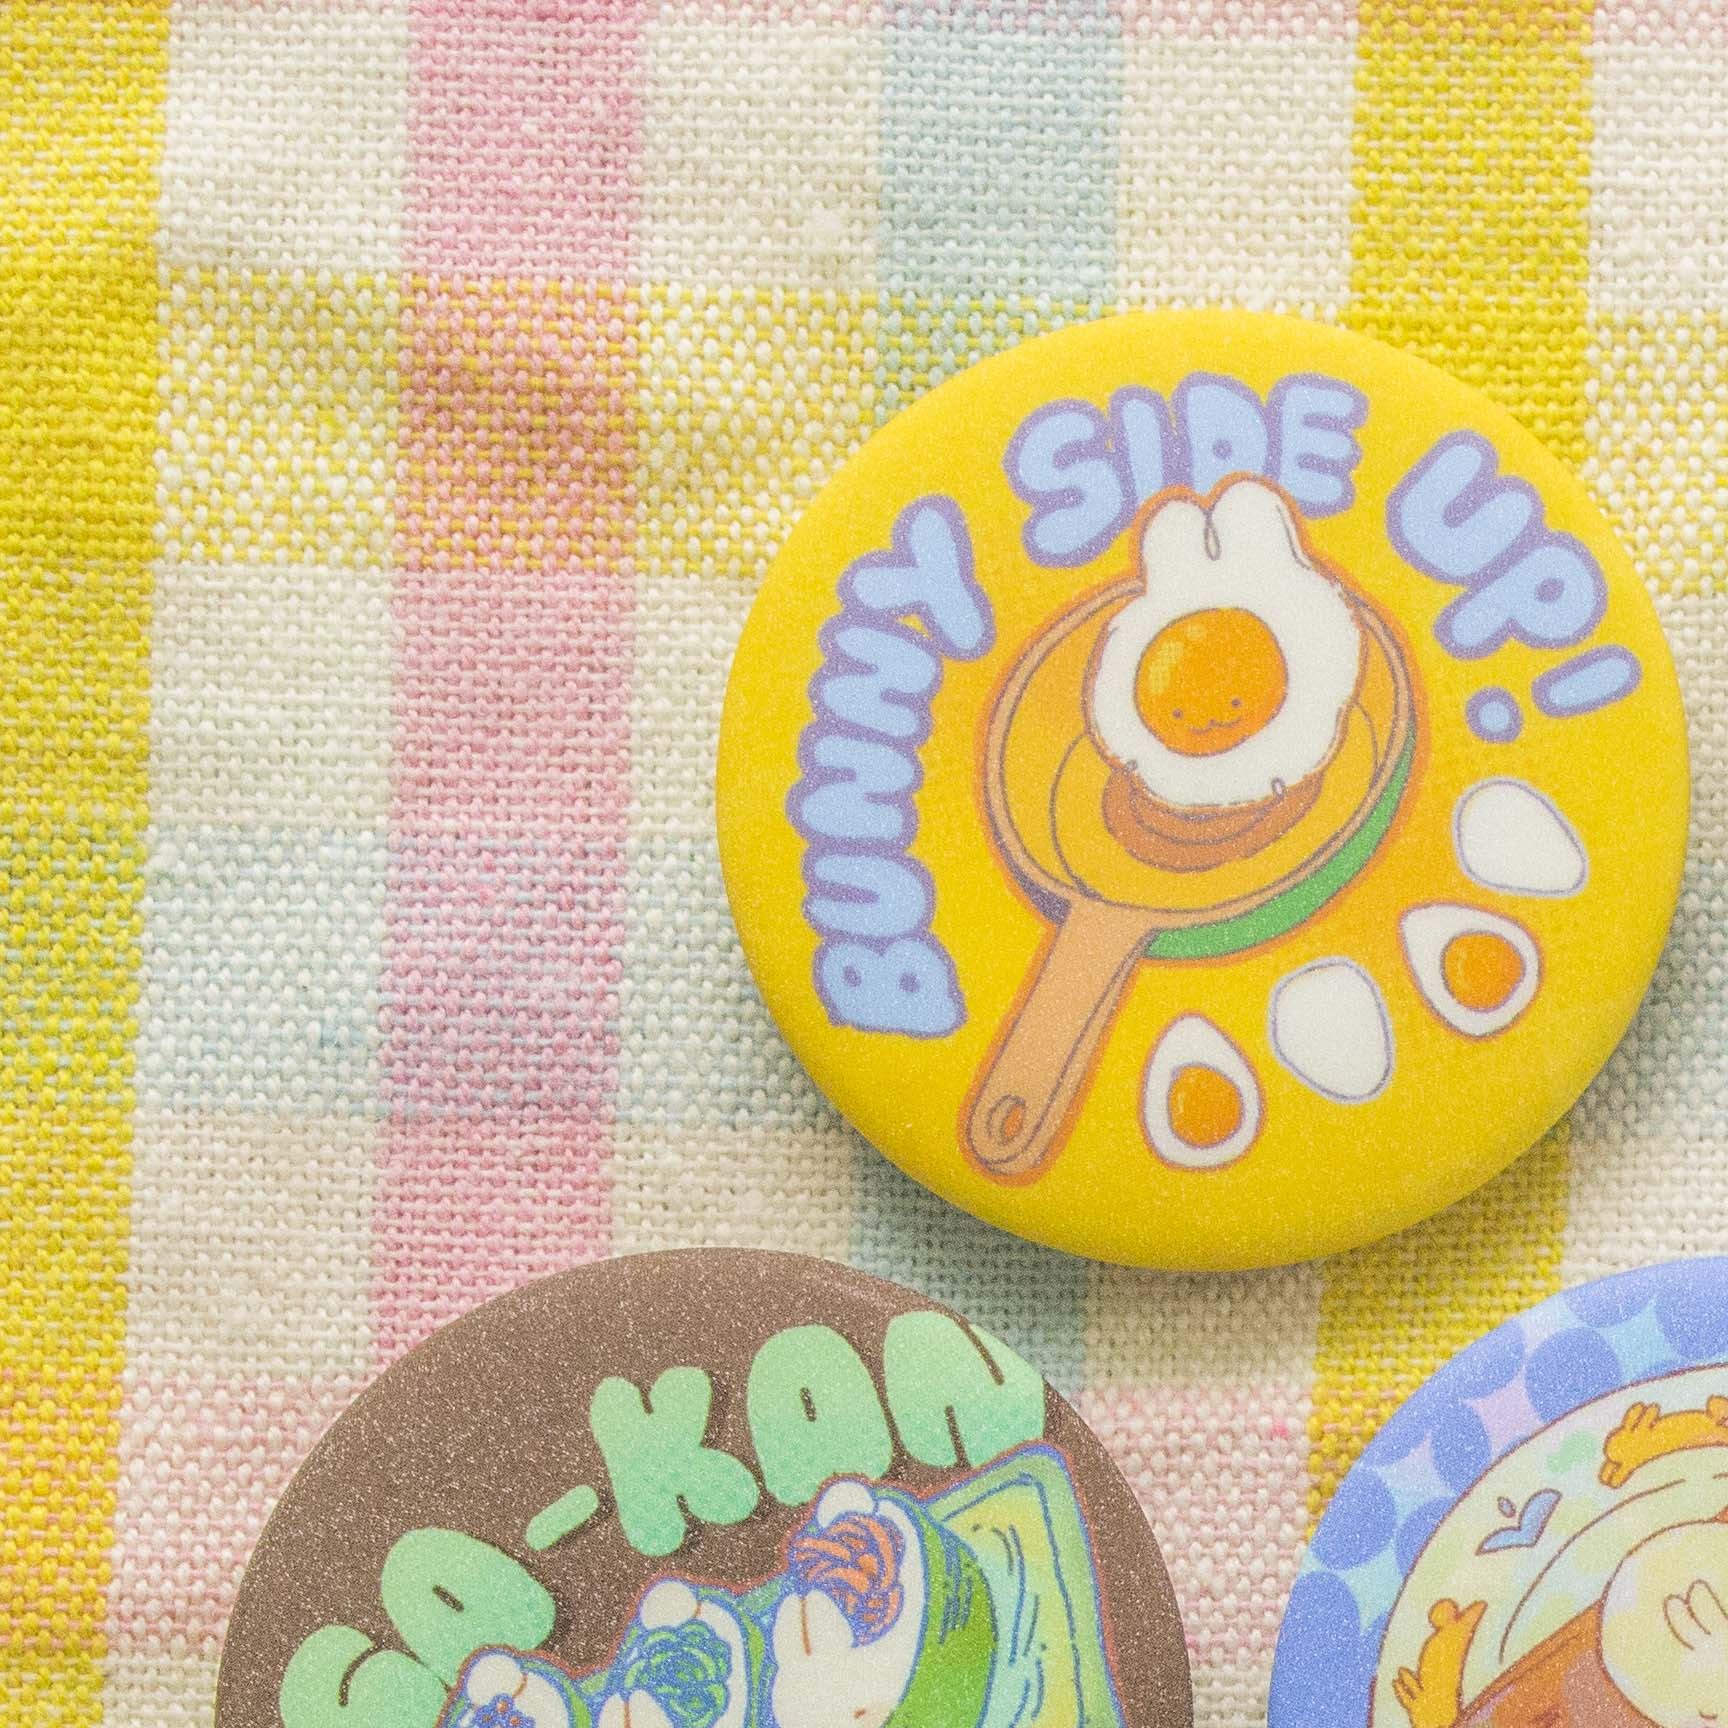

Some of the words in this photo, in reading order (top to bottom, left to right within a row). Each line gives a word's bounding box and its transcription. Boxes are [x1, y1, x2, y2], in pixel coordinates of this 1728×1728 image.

[786, 495, 995, 1037] BUNNY
[1003, 372, 1369, 568] SIDE
[1386, 429, 1642, 743] UP!
